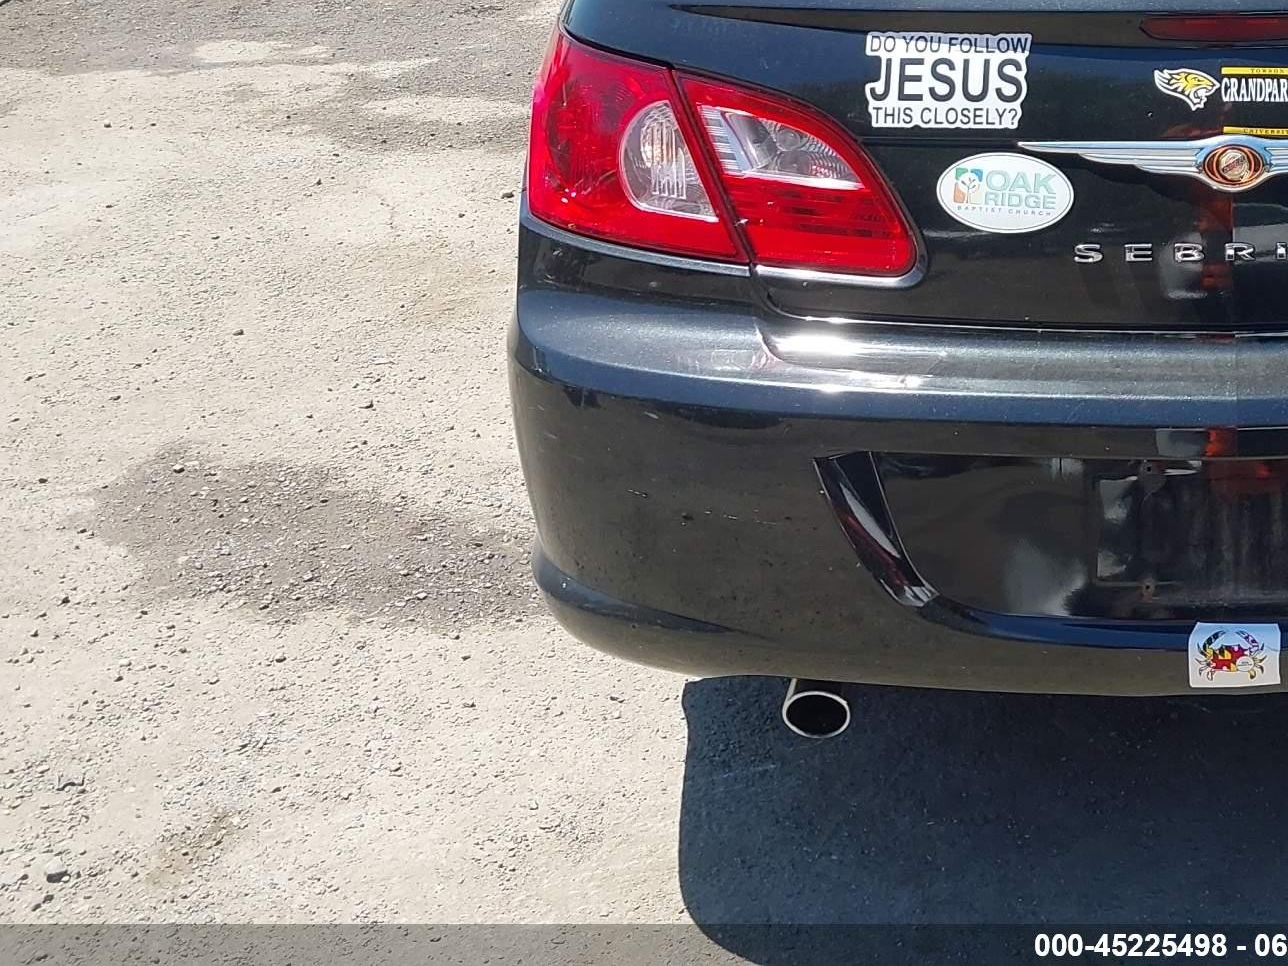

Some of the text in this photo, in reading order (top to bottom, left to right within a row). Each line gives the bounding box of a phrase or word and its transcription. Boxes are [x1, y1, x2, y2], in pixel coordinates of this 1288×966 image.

[869, 35, 1029, 54] DO YOU FOLLOW
[870, 57, 1023, 102] JESUS
[872, 106, 1018, 126] THIS CLOSELY?
[985, 169, 1057, 195] OAK
[984, 191, 1057, 210] RIDGE
[1008, 208, 1052, 216] CHURCH
